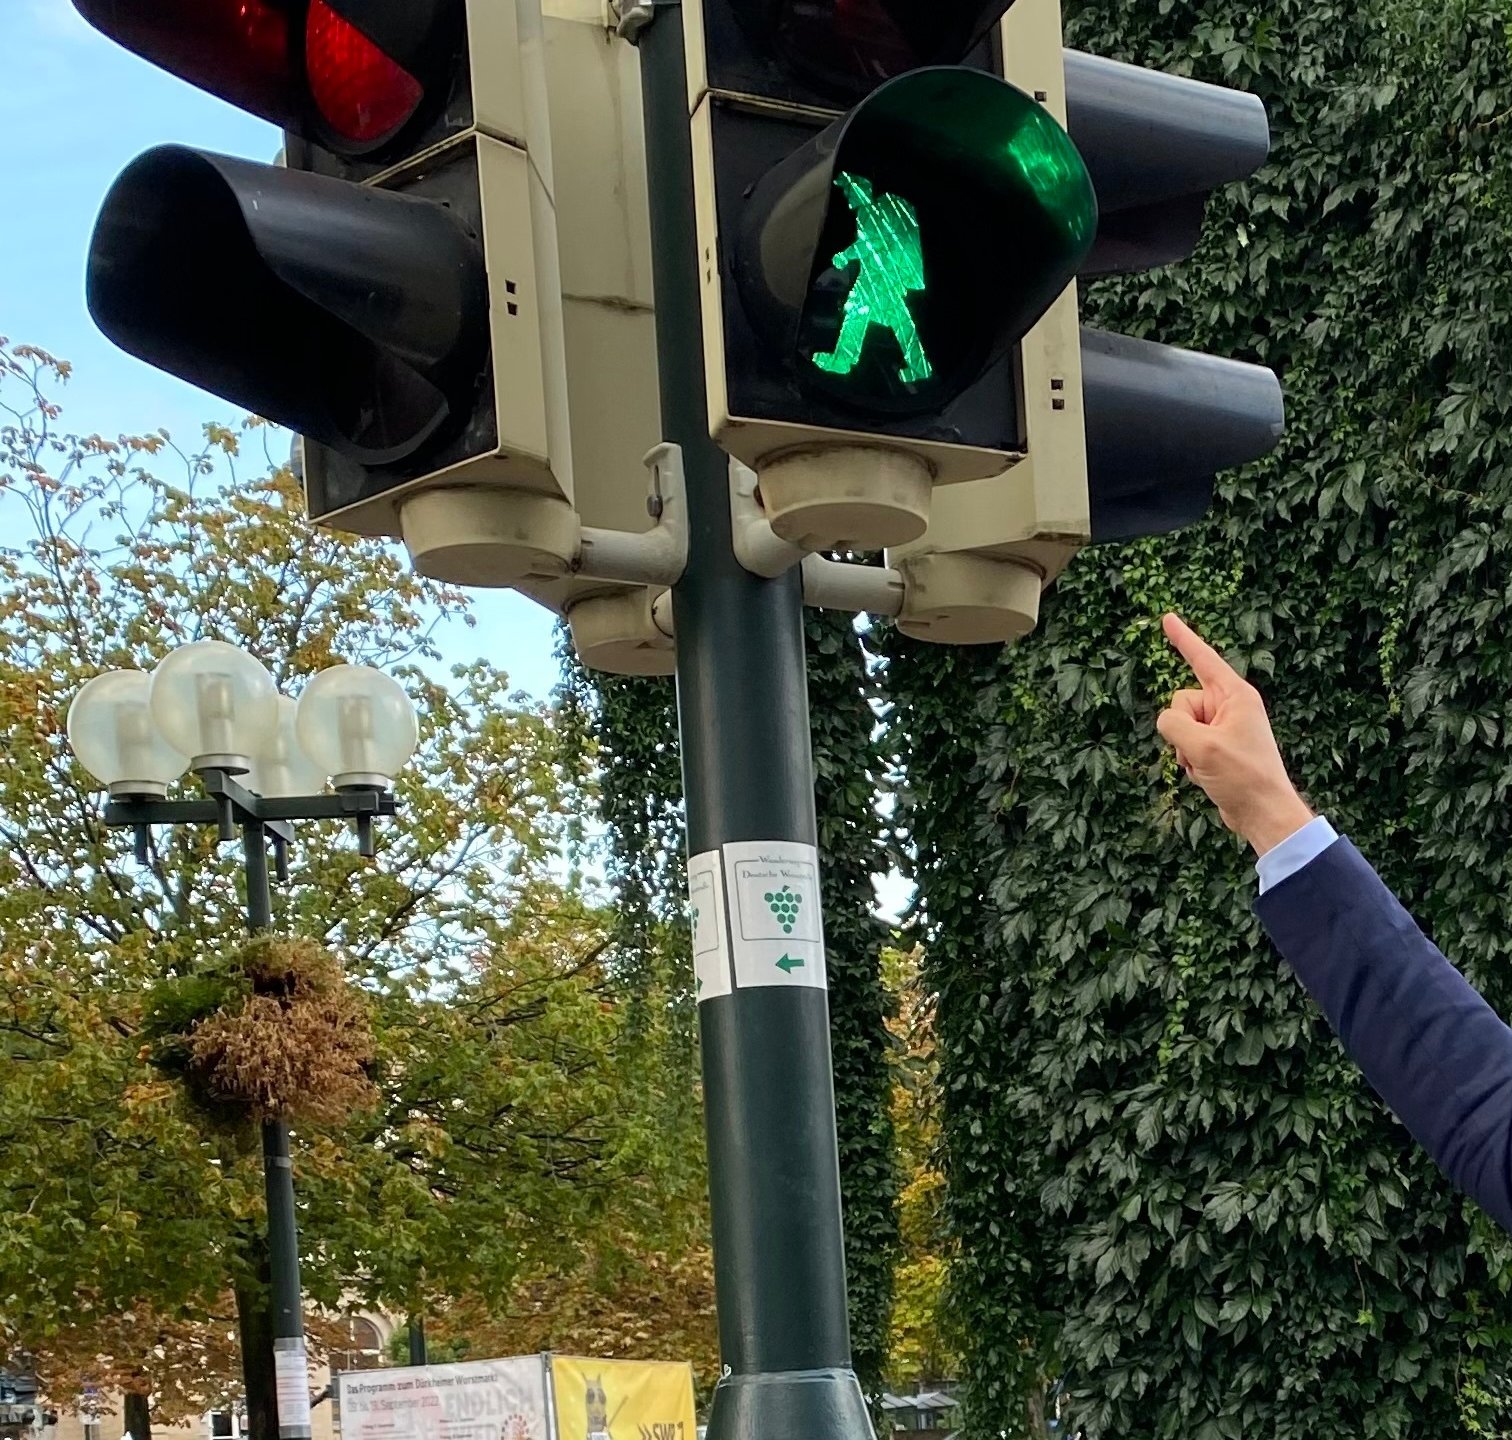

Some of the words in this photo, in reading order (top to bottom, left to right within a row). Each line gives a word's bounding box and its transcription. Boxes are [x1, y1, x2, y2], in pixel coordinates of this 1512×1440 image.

[347, 1384, 358, 1394] Das
[360, 1383, 396, 1395] Programm
[397, 1381, 414, 1391] zum
[415, 1377, 454, 1389] Dürkheimer
[455, 1375, 498, 1385] Wurstmarkt
